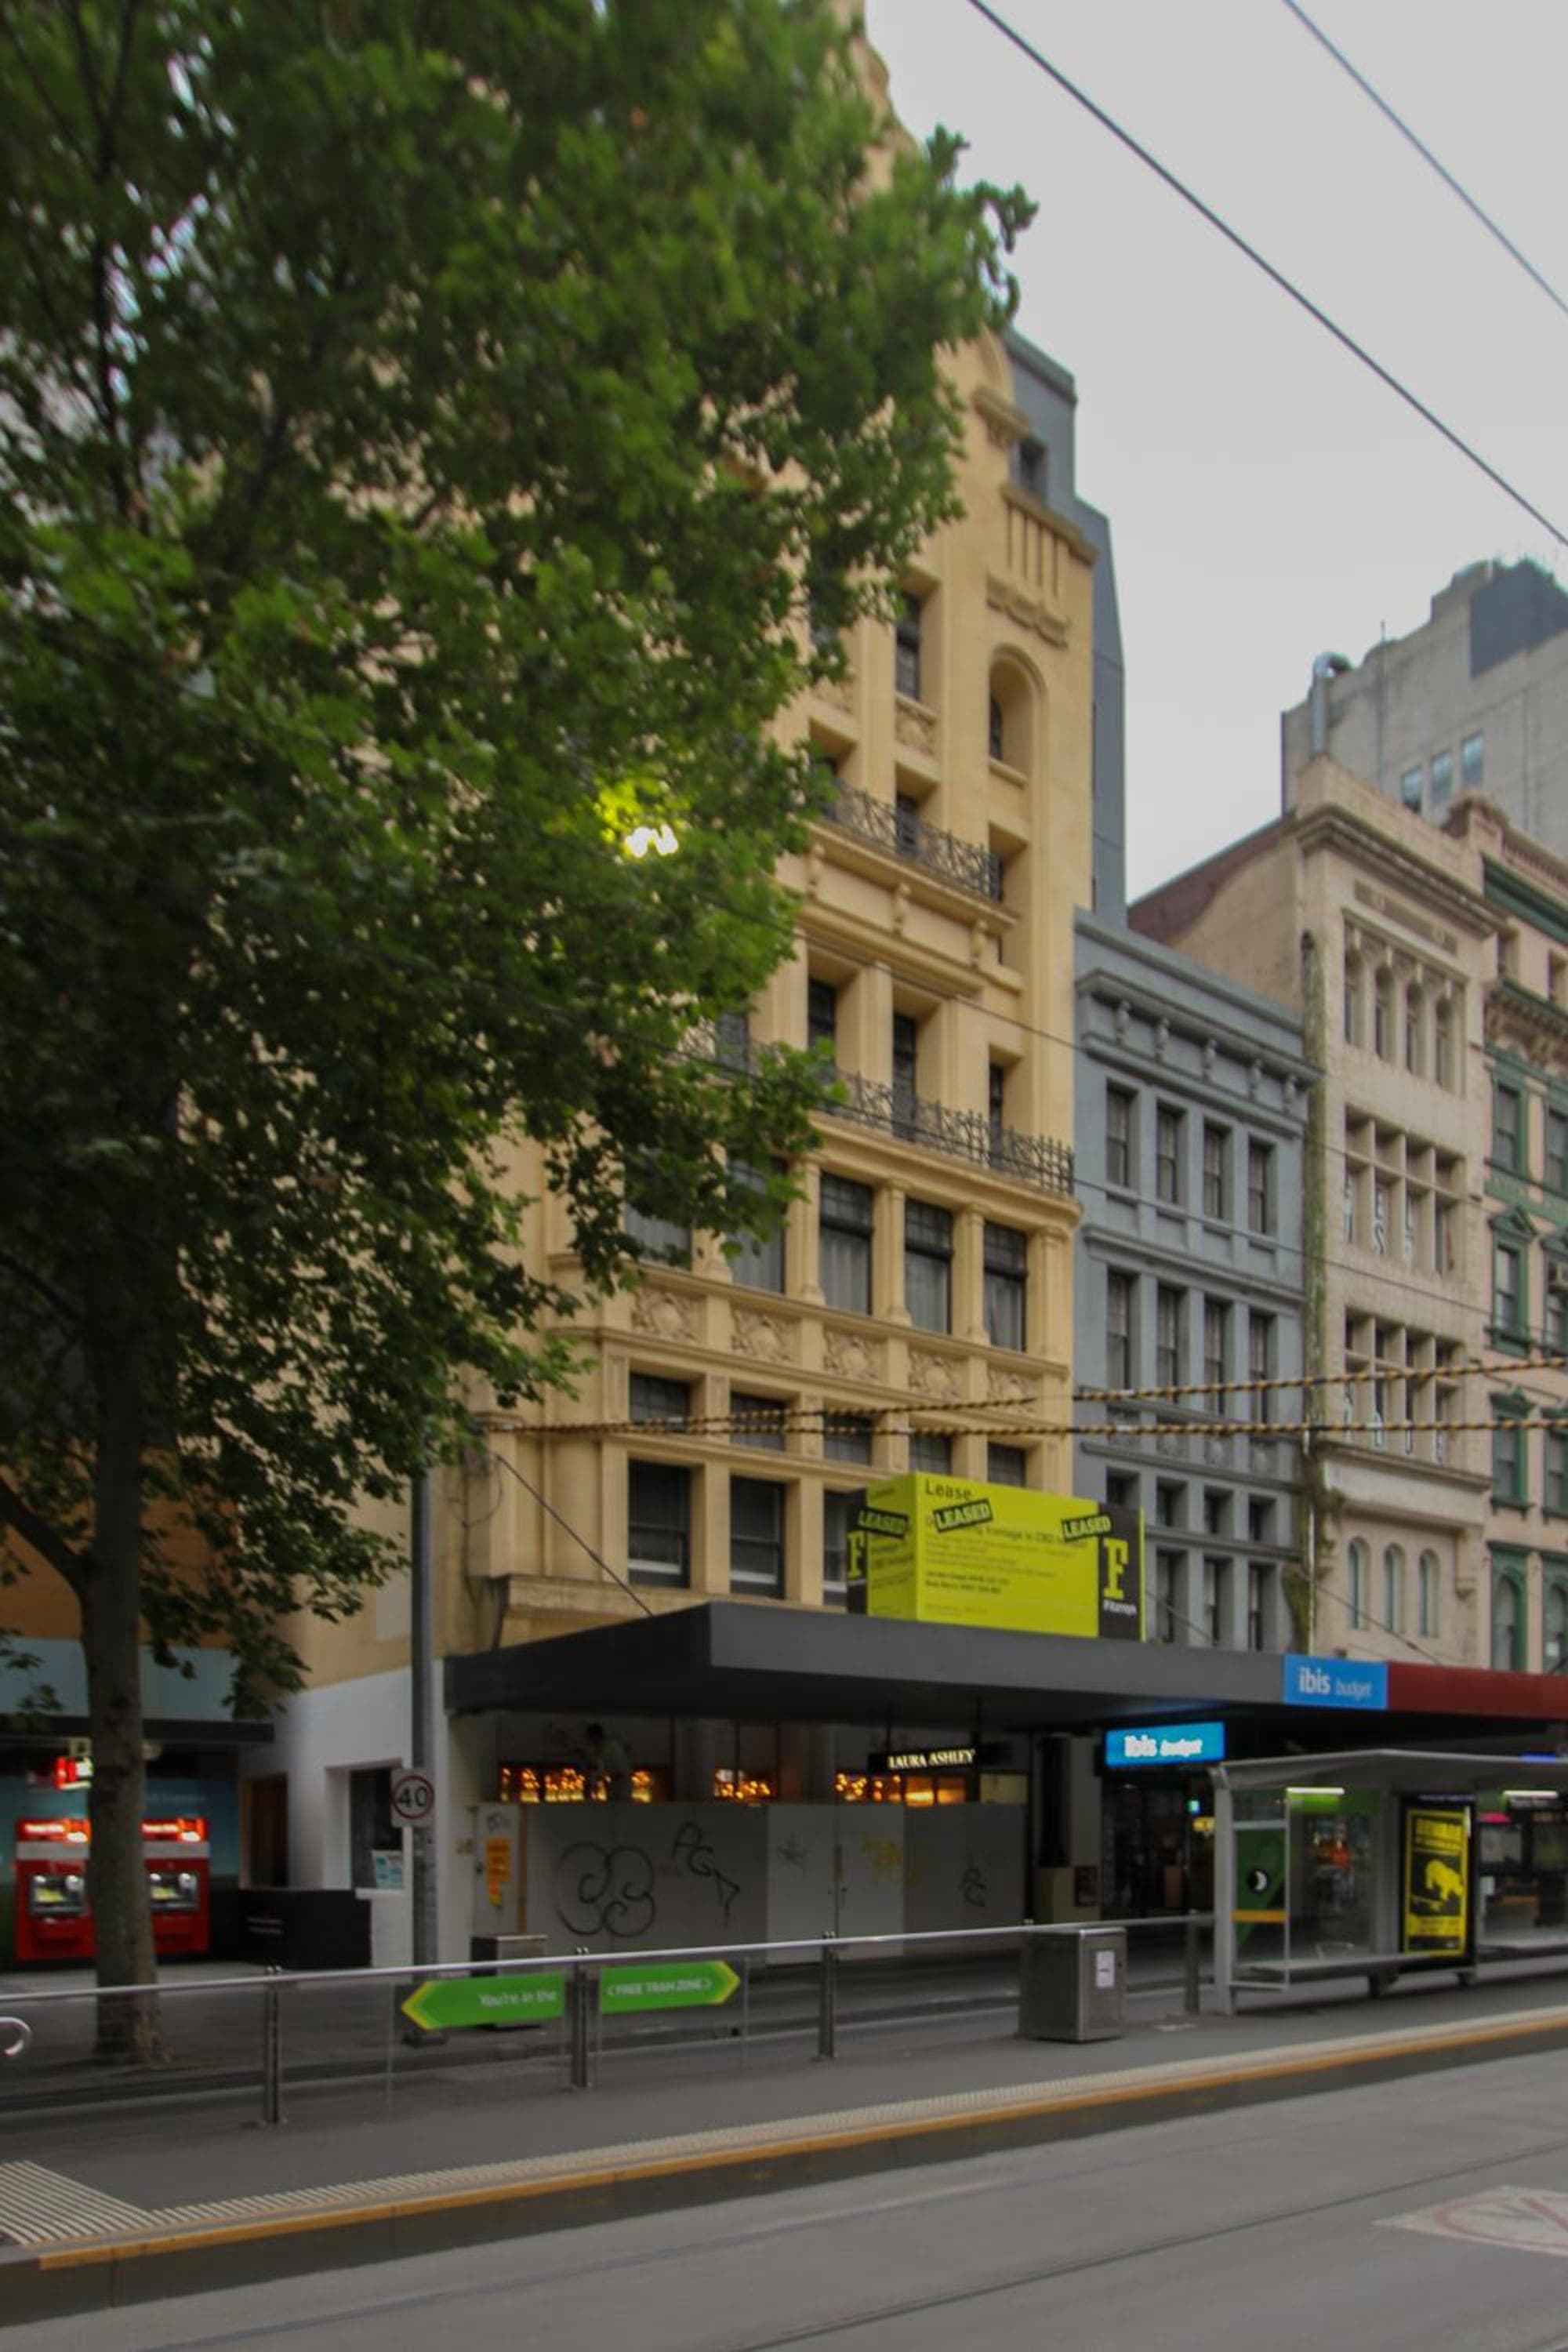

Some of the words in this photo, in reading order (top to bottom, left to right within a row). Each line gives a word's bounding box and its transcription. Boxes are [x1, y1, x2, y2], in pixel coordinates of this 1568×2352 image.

[925, 1479, 972, 1500] Lease
[858, 1508, 906, 1535] LEASED
[935, 1501, 992, 1530] LEASED
[1064, 1515, 1112, 1539] LEASED
[1103, 1537, 1129, 1599] F
[1298, 1666, 1330, 1694] ibis
[1335, 1677, 1373, 1701] budget
[1124, 1734, 1157, 1757] ibis
[888, 1755, 927, 1769] LAURA
[928, 1748, 975, 1766] ASHLEY
[399, 1786, 428, 1808] 40
